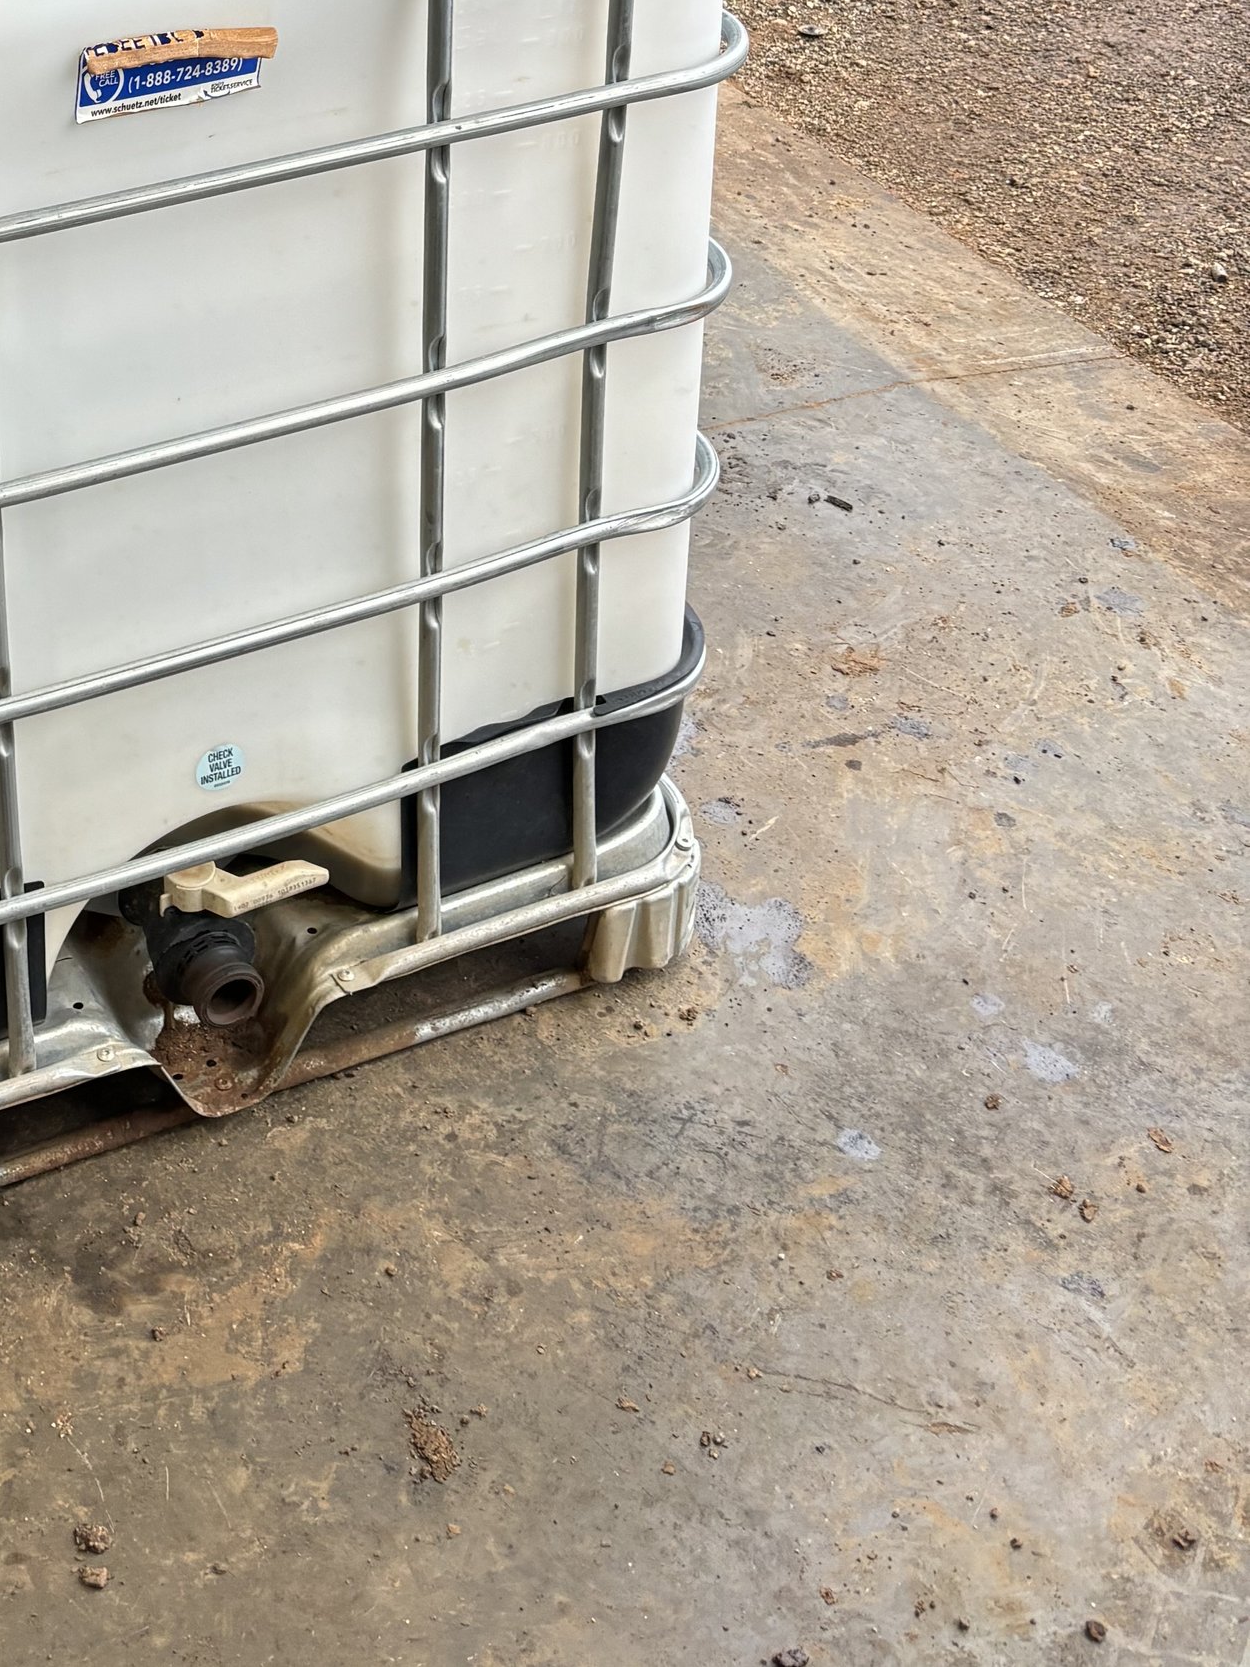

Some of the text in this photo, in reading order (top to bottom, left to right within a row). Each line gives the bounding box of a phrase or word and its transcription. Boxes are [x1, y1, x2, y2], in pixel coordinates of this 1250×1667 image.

[95, 70, 116, 81] FREE
[98, 77, 119, 87] CALL
[128, 57, 243, 94] (1-888-724-8389)
[91, 92, 182, 117] www.schuetz.net/ticket
[207, 747, 234, 763] CHECK
[209, 758, 233, 773] VALVE
[200, 766, 242, 785] INSTALLED
